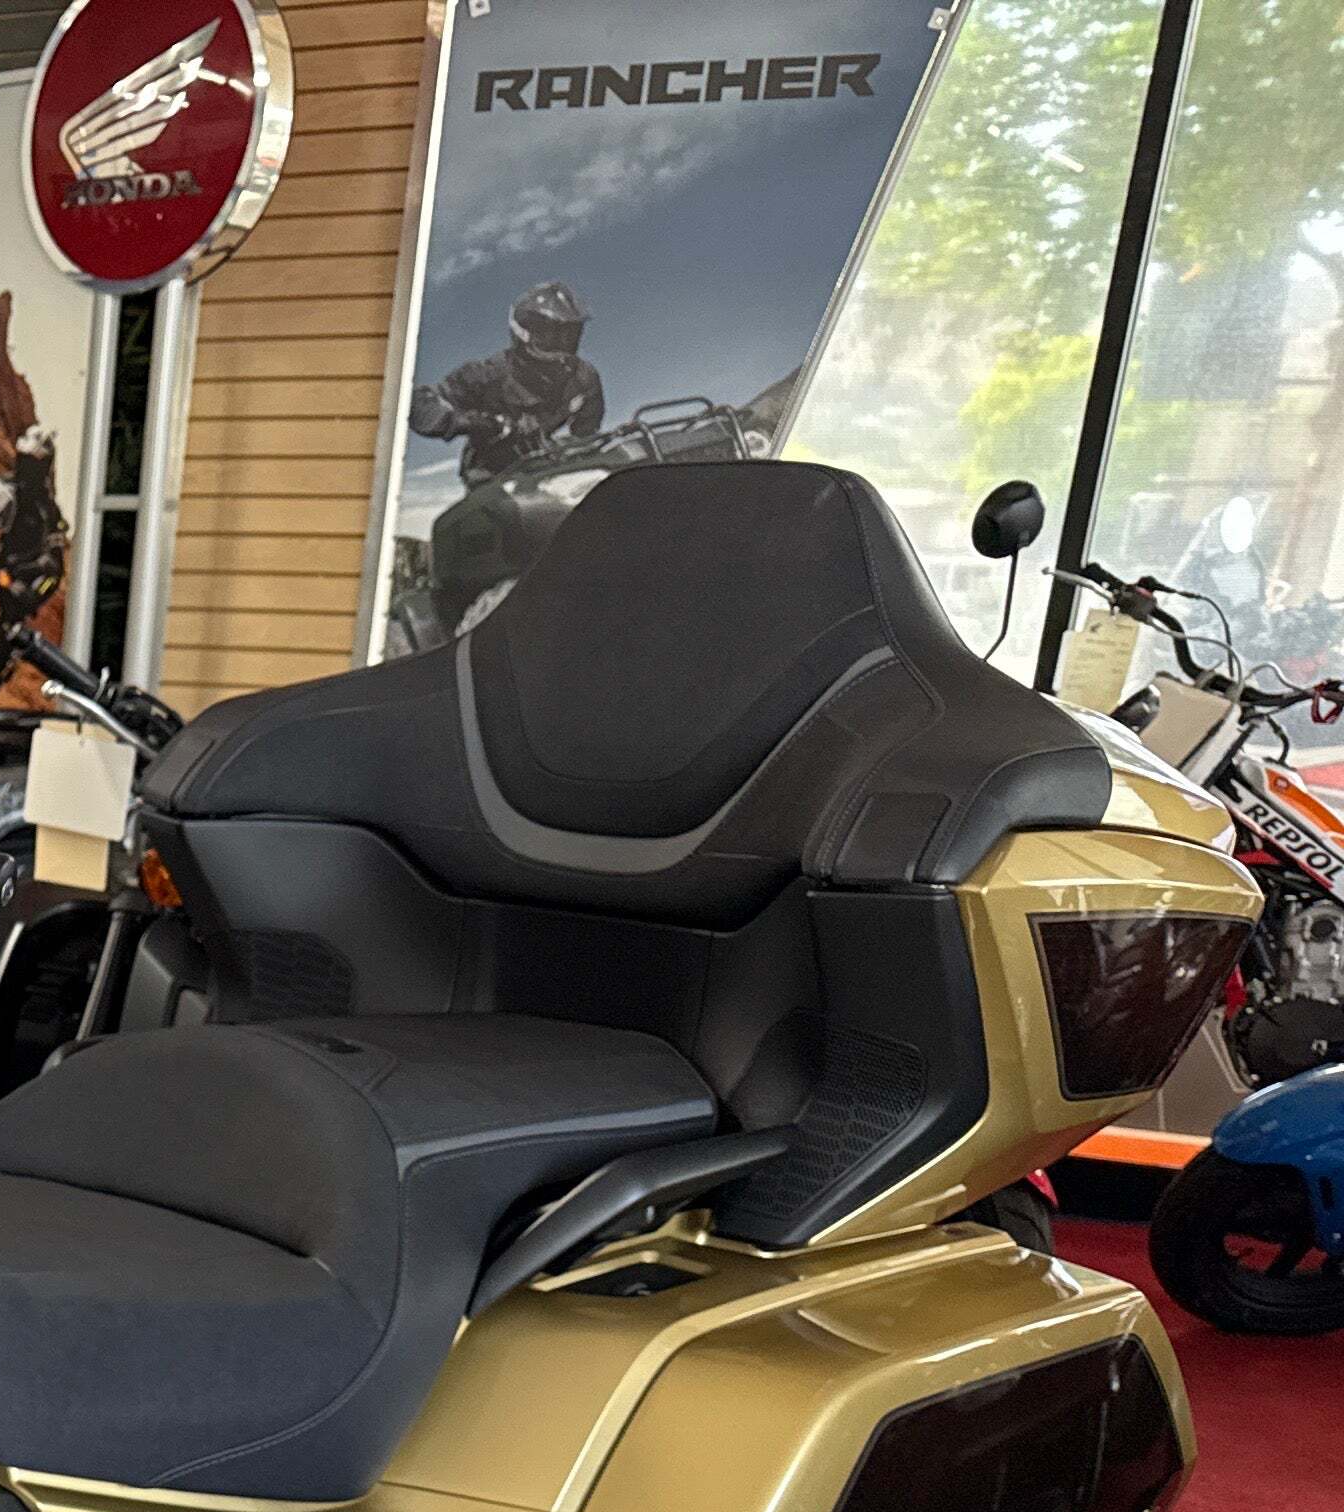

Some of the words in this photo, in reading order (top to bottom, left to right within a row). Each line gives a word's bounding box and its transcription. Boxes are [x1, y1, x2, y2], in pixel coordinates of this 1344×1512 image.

[473, 52, 882, 113] RANCHER
[62, 169, 202, 208] HONDA
[1243, 803, 1343, 882] REPSOL
